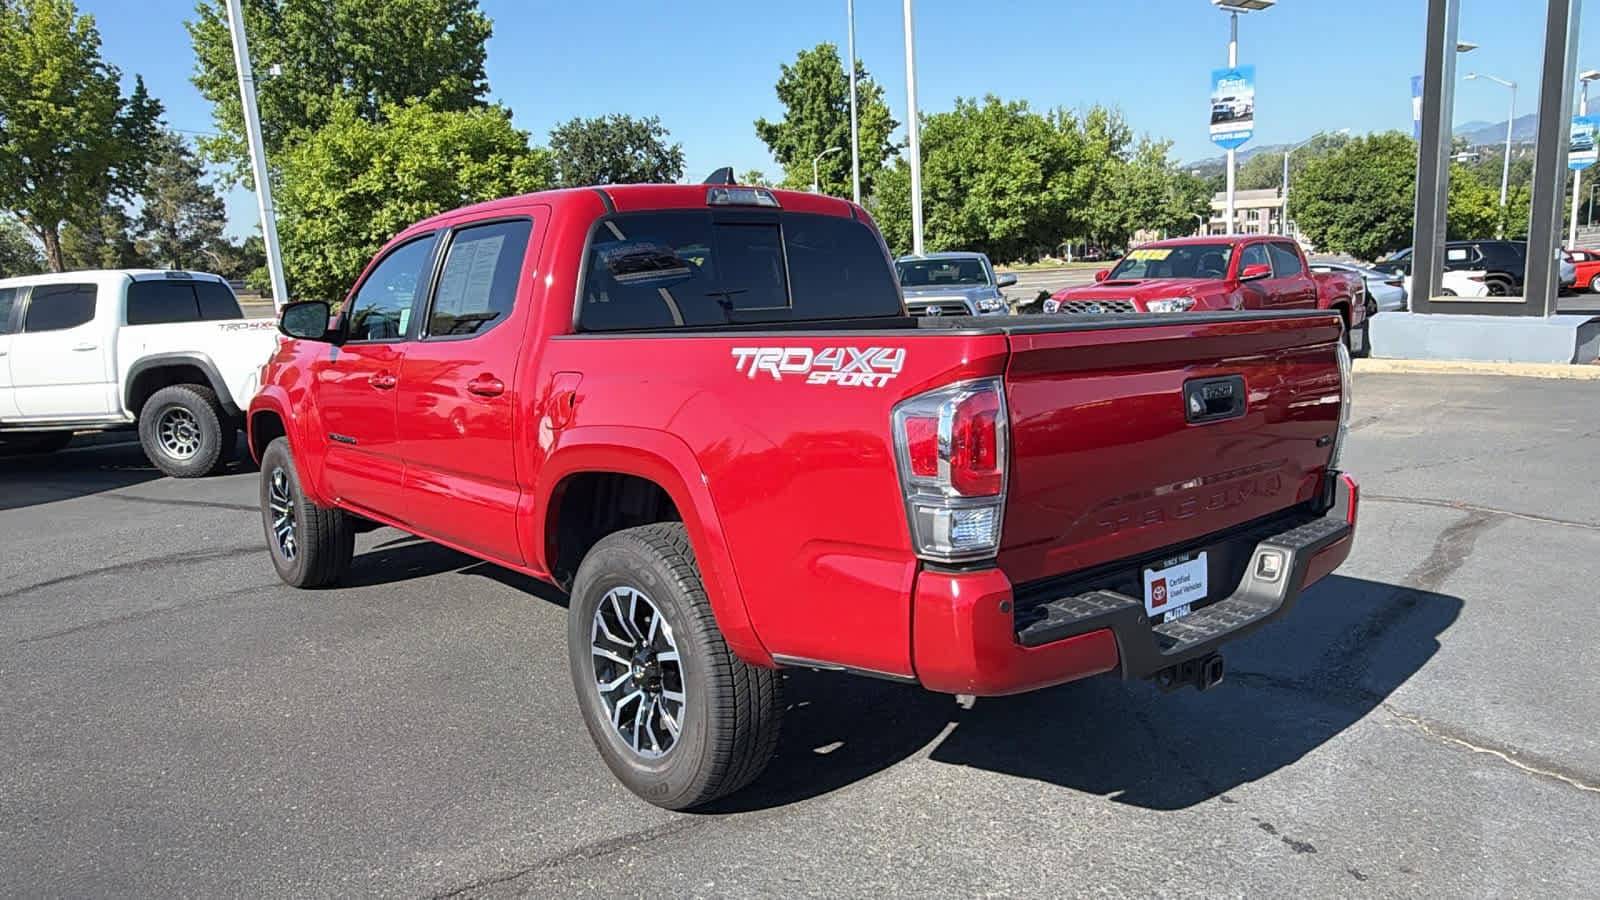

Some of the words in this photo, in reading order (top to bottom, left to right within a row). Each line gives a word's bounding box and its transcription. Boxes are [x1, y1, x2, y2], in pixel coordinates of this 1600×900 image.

[731, 347, 814, 381] TRD
[813, 347, 906, 373] 4X4
[806, 371, 898, 388] SPORT
[1169, 574, 1191, 587] Certified
[1170, 588, 1182, 598] Used
[1183, 582, 1202, 593] Vehicles
